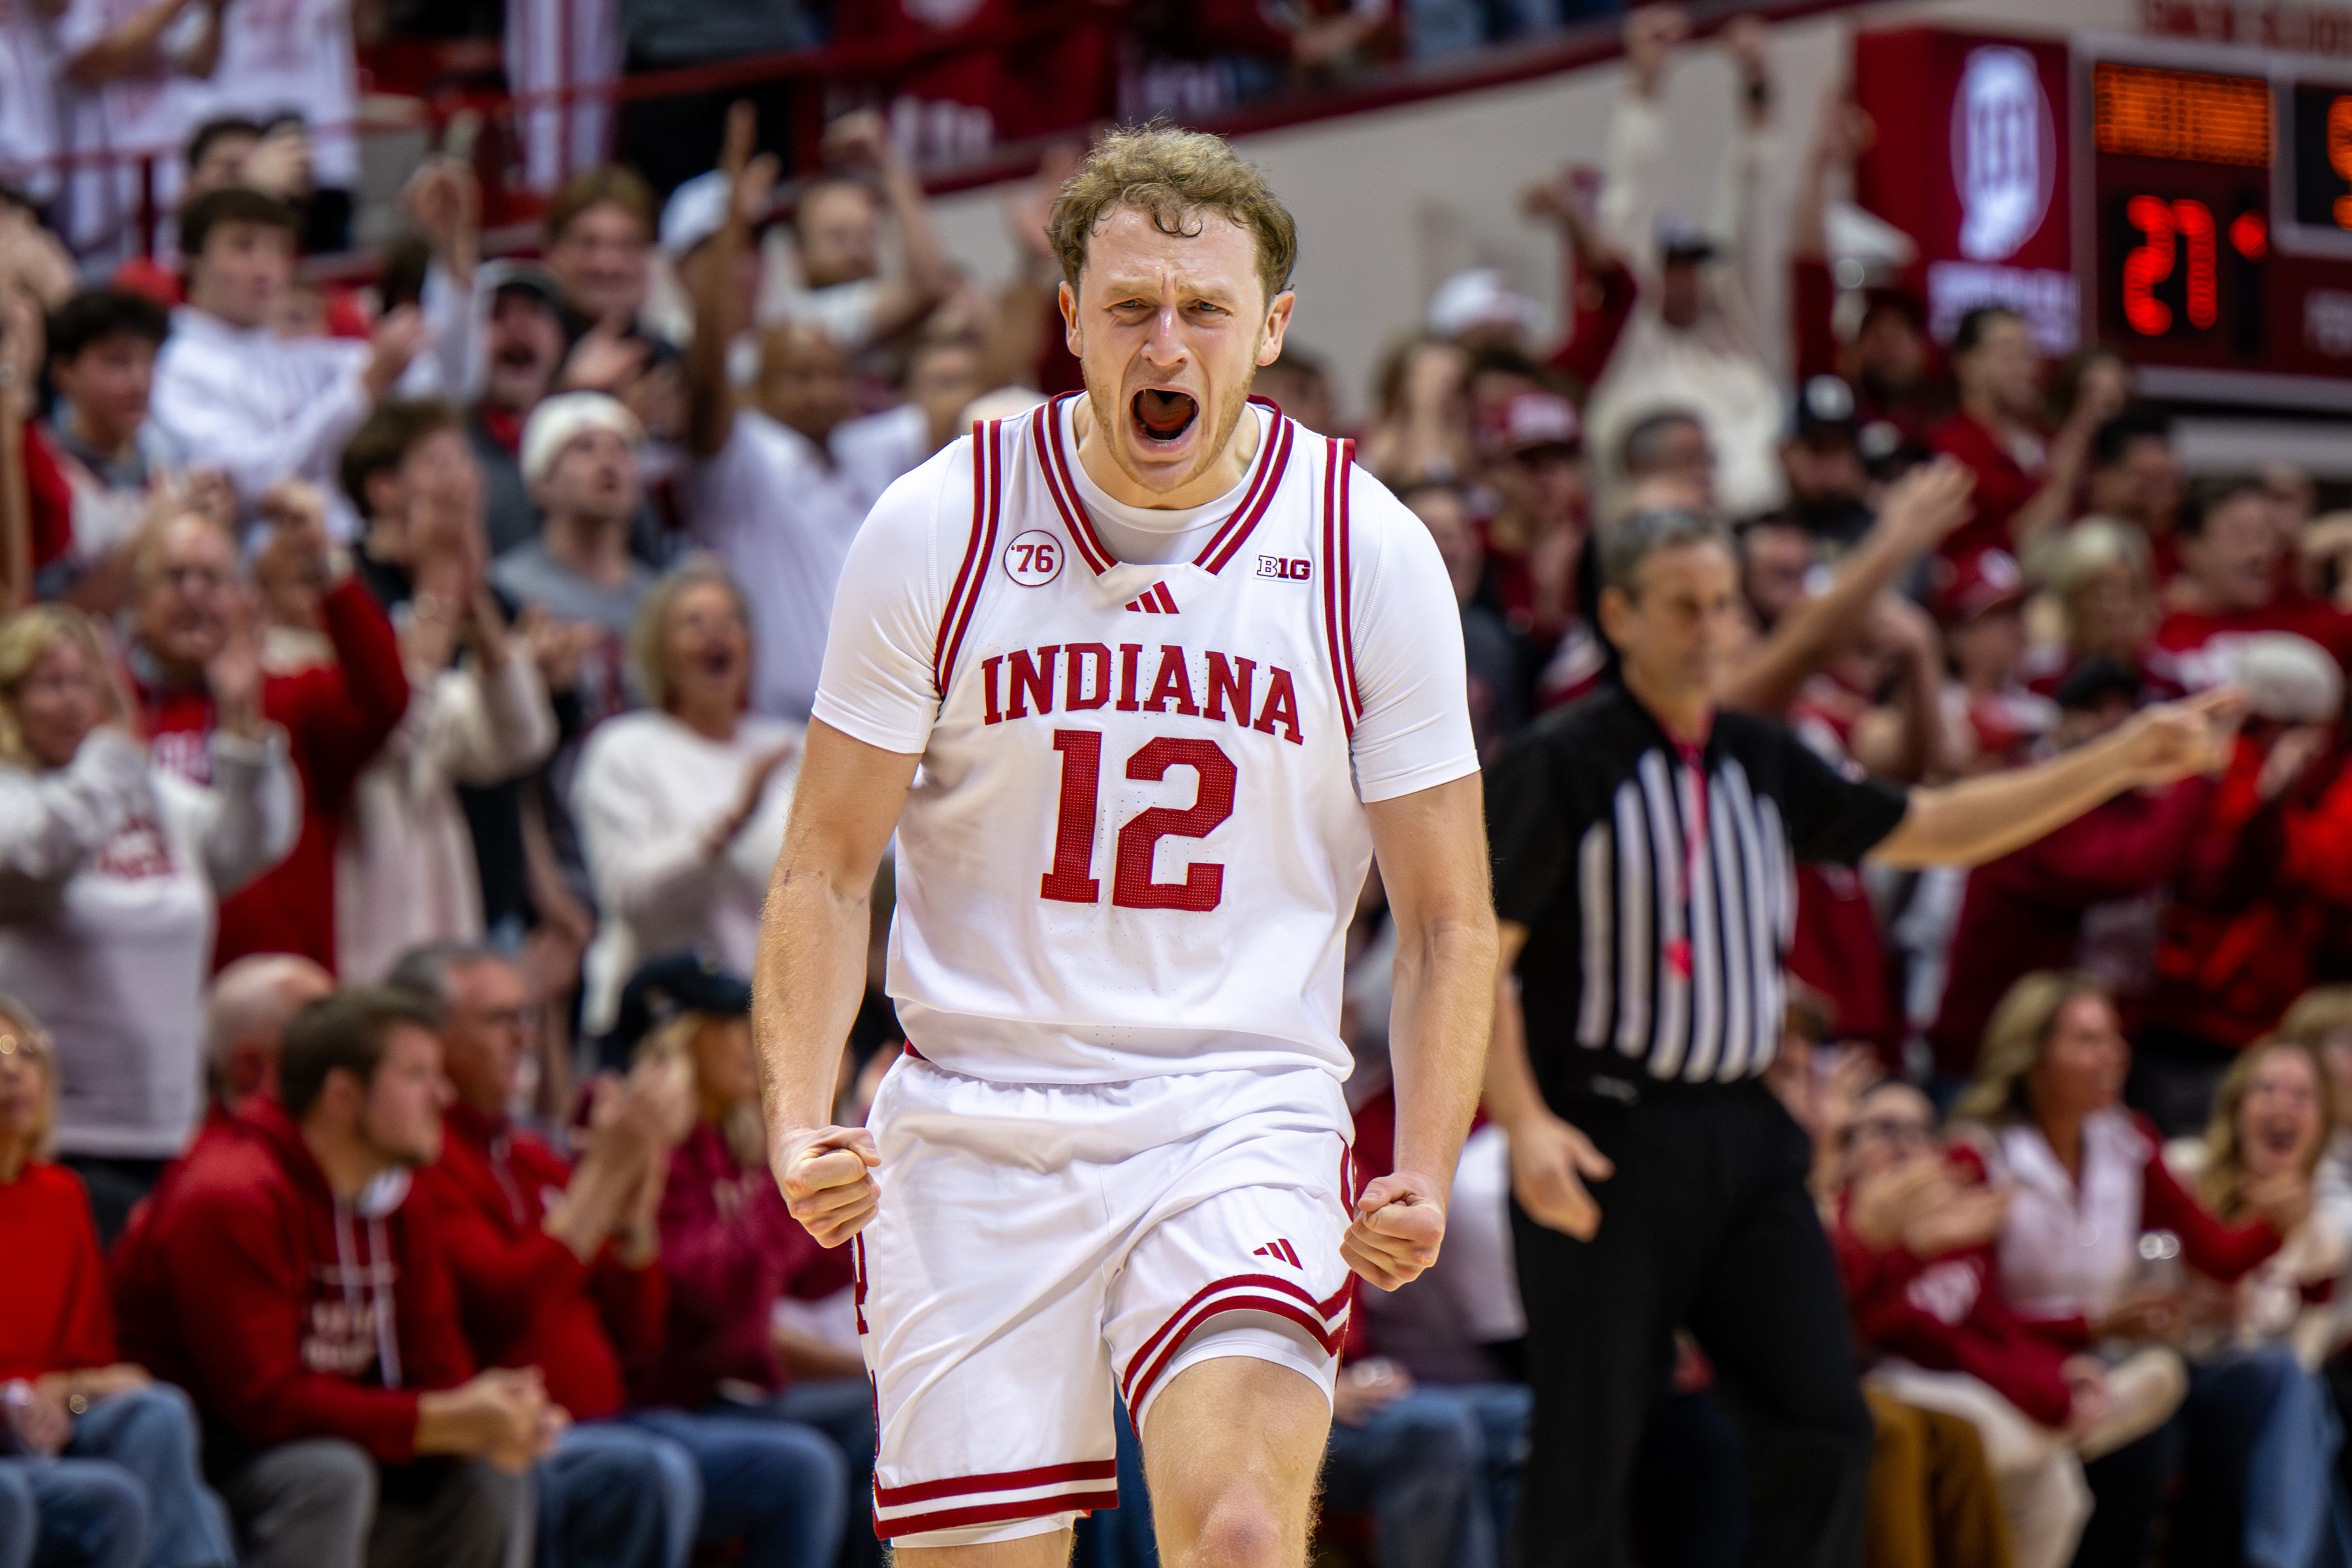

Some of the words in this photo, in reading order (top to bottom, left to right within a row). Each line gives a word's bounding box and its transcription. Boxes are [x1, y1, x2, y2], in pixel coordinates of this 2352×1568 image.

[2123, 195, 2217, 335] 27
[1011, 544, 1054, 572] '76
[981, 642, 1303, 745] INDIANA
[1040, 729, 1237, 911] 12
